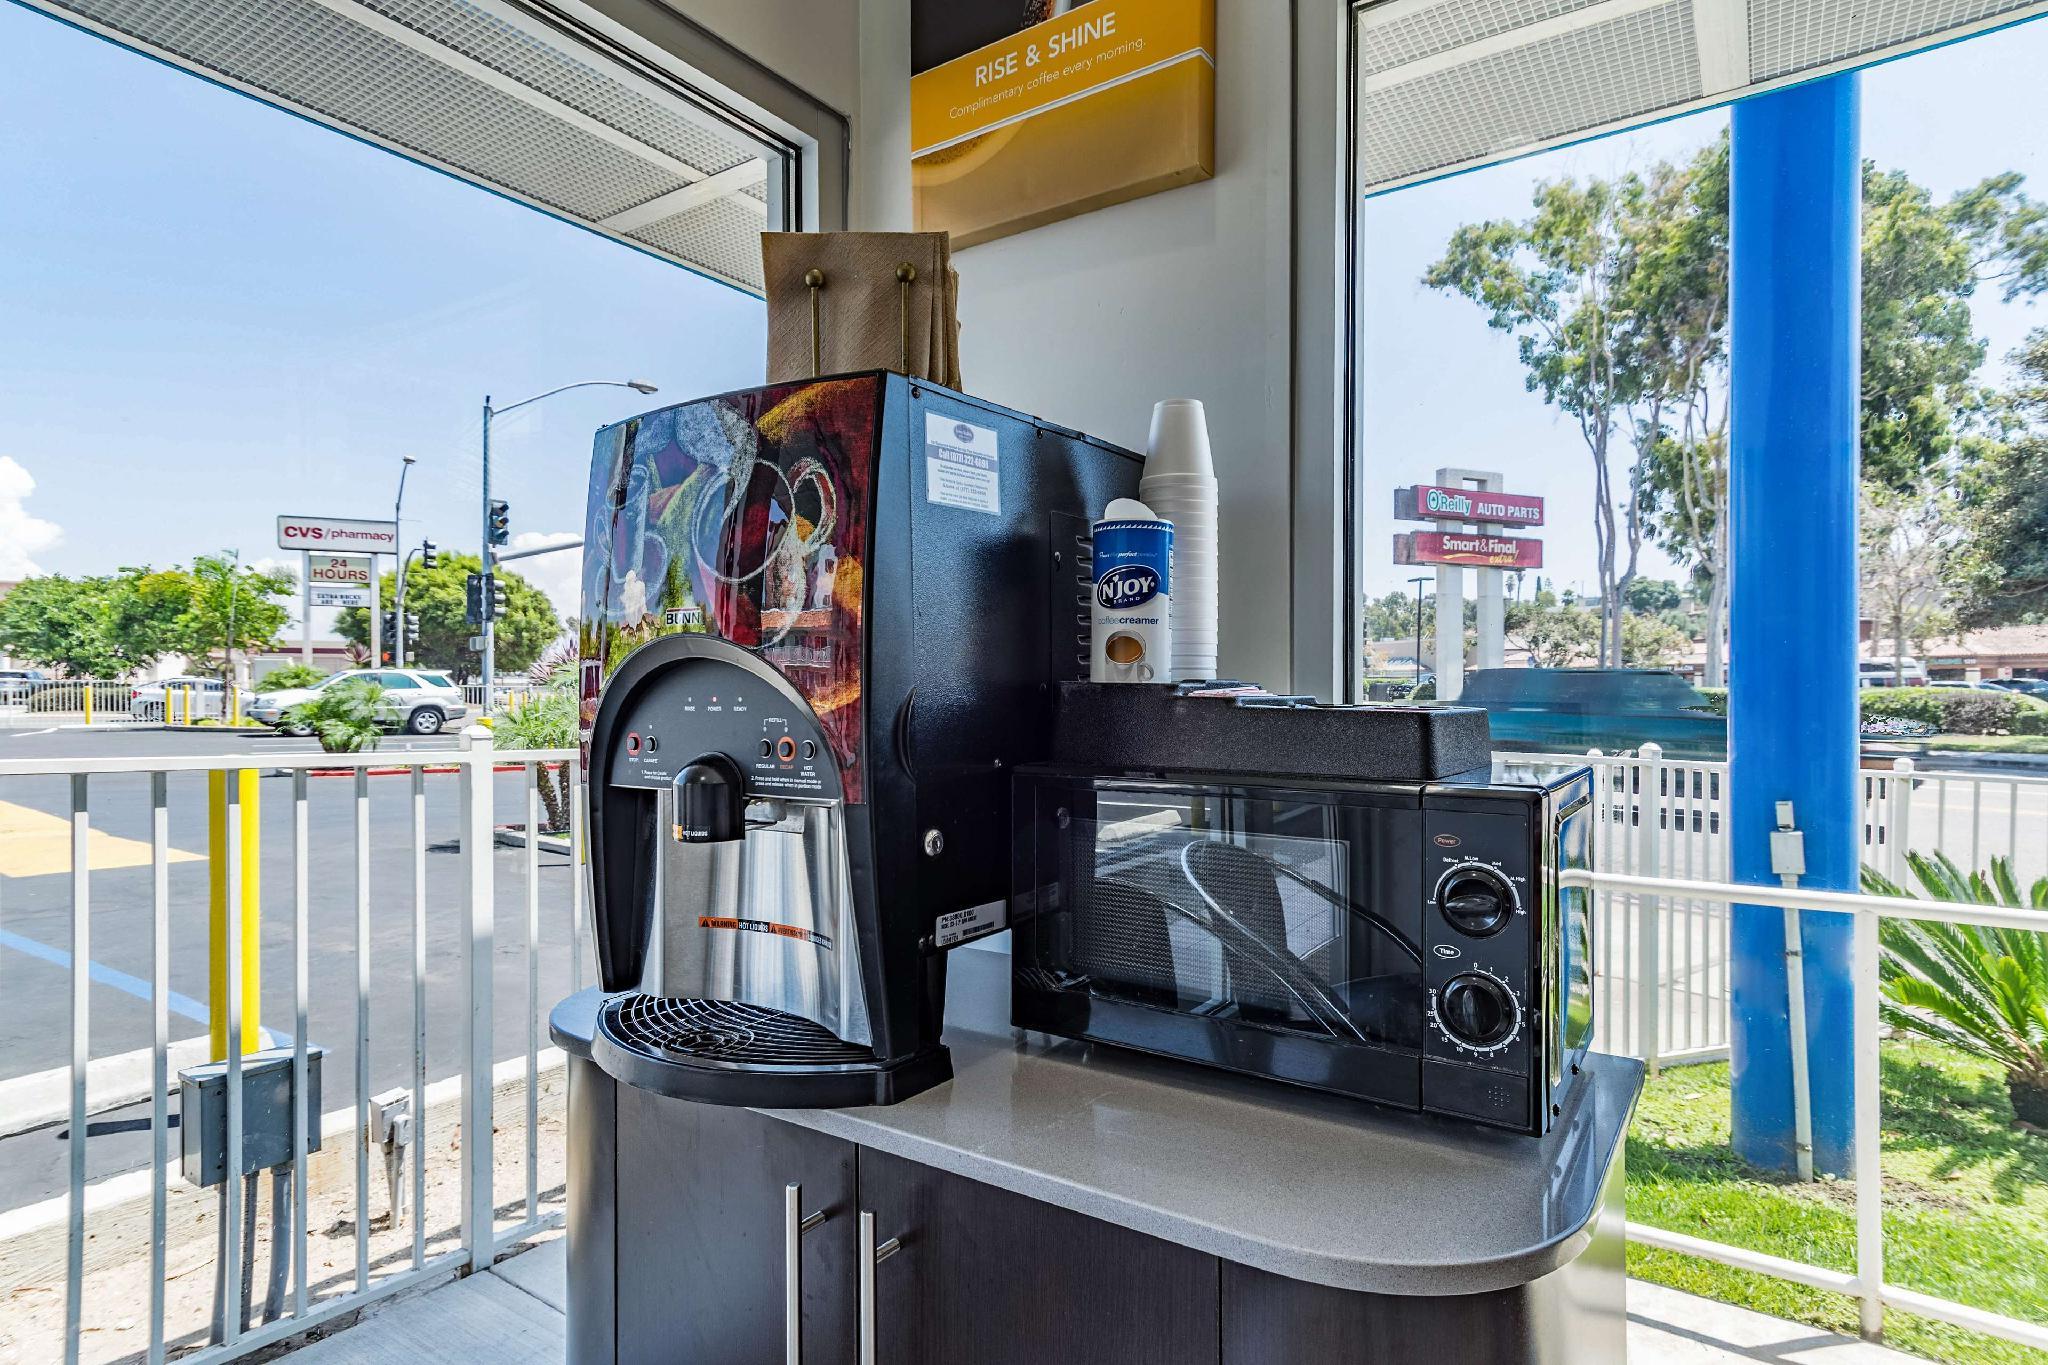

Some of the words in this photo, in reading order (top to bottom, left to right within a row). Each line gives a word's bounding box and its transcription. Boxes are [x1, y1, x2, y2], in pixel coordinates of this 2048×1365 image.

[975, 52, 1019, 87] RISE
[1025, 44, 1041, 67] &
[1048, 12, 1116, 59] SHINE
[949, 85, 1024, 119] Complimentary
[1027, 70, 1060, 90] coffee
[1063, 57, 1093, 79] every
[1096, 38, 1146, 65] morning.
[1427, 489, 1473, 516] O'Reilly
[1477, 503, 1505, 516] AUTO
[1507, 506, 1540, 519] PARTS
[331, 558, 348, 568] 24
[313, 568, 368, 580] HOURS
[666, 611, 701, 625] BUNN
[1437, 837, 1457, 845] Power
[711, 920, 737, 929] WARNING
[738, 922, 749, 930] HOT
[1440, 948, 1455, 956] Time
